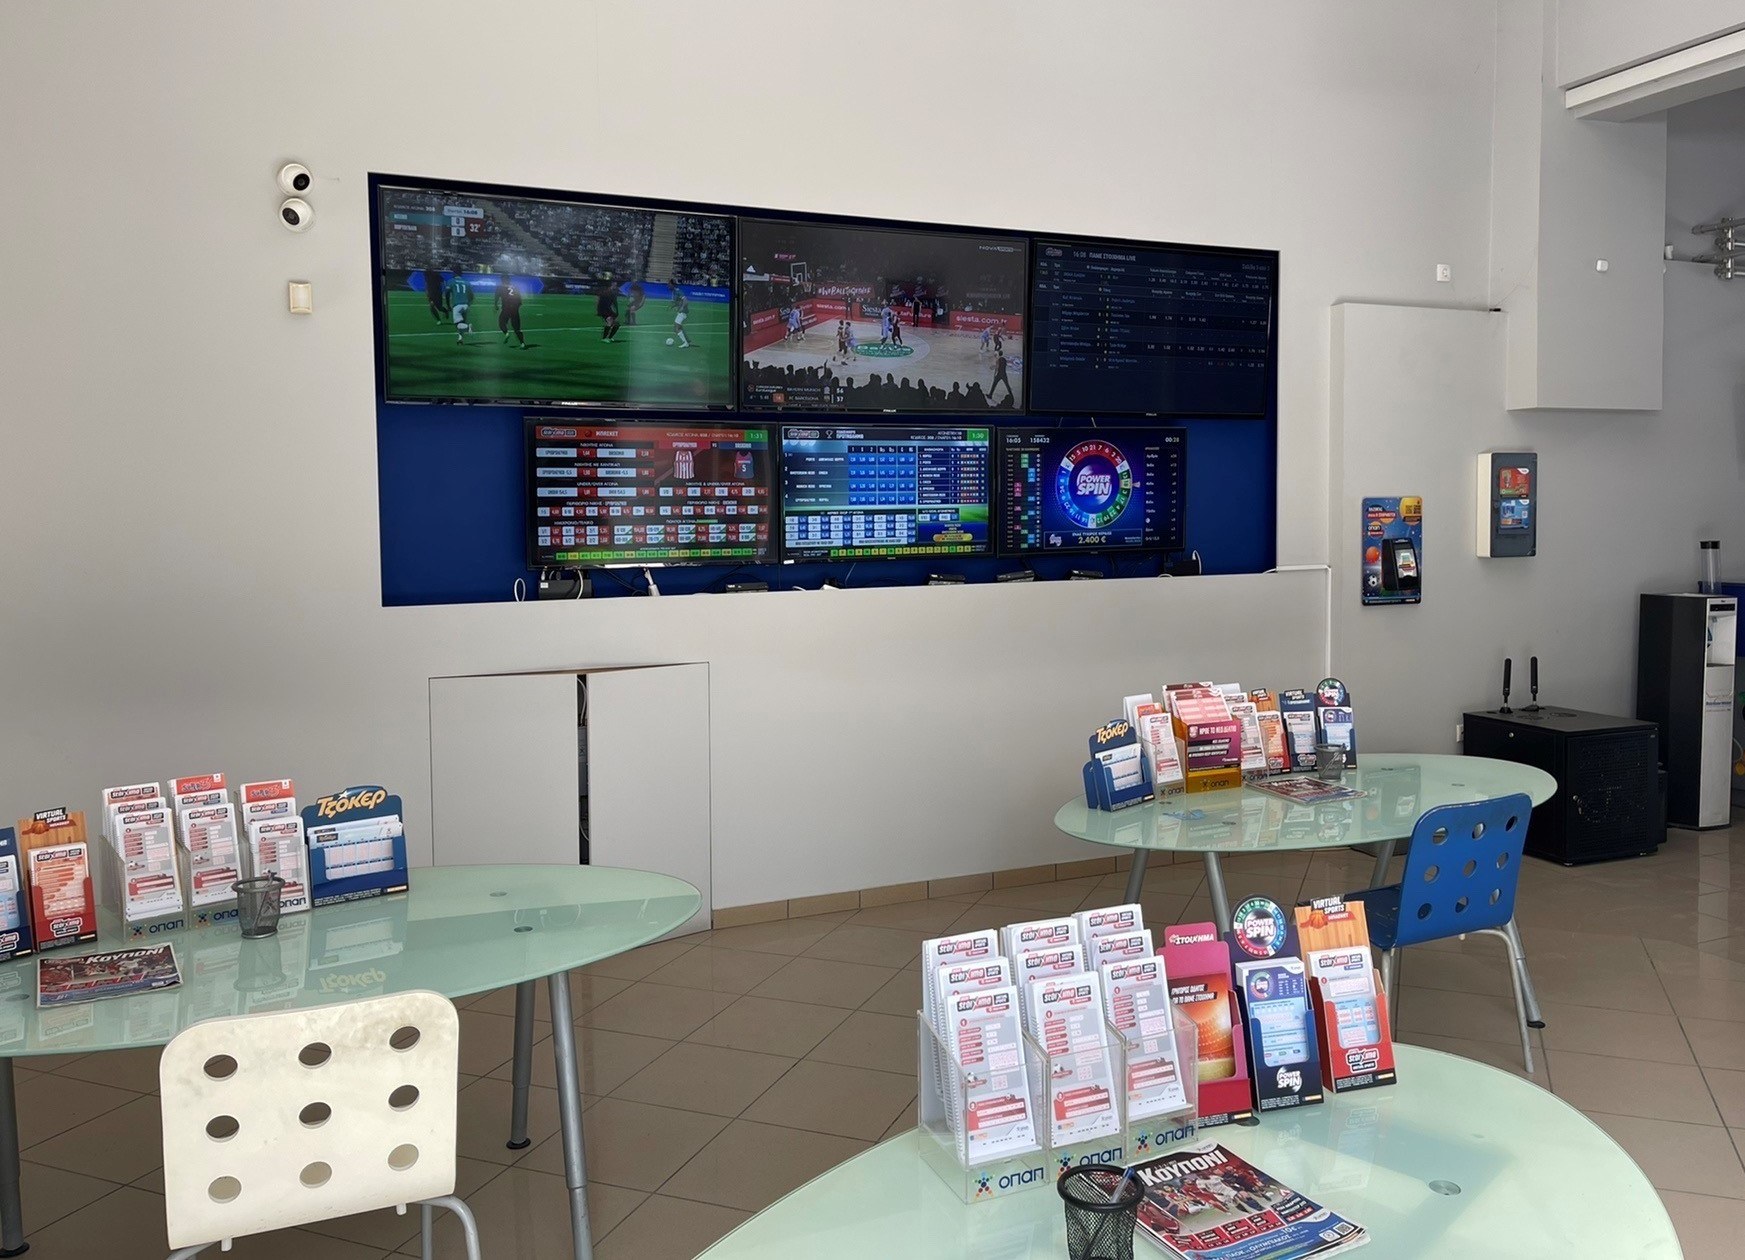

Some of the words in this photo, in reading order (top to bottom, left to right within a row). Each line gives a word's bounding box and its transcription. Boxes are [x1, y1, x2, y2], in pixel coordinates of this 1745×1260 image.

[455, 283, 466, 293] 11
[507, 287, 514, 296] 2
[1080, 475, 1111, 483] POWER
[1077, 482, 1110, 495] SPIN
[36, 809, 64, 820] VIRTUAL
[46, 815, 66, 823] SPORTS
[1313, 897, 1341, 909] VIRTUAL
[1324, 904, 1345, 914] SPORTS
[1247, 918, 1274, 927] POWER
[1246, 926, 1274, 939] SPIN
[1280, 1070, 1300, 1079] POWER
[1277, 1077, 1300, 1088] SPIN
[1137, 1150, 1228, 1187] ΚΟΥΠΟΝΙ
